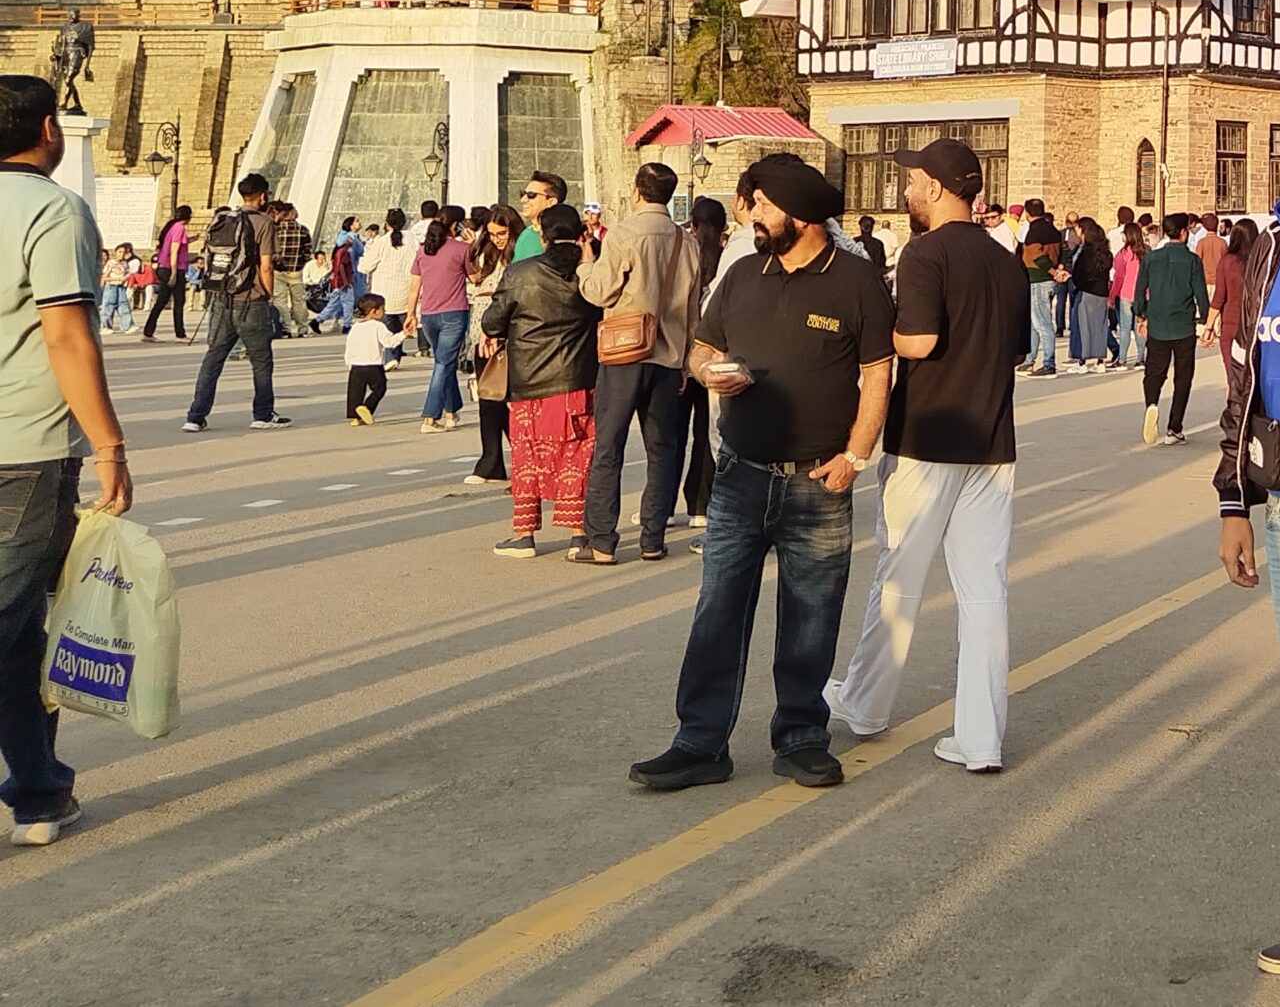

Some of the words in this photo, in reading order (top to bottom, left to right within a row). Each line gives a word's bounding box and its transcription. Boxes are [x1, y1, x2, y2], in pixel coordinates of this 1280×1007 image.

[876, 55, 898, 66] STATE
[898, 52, 927, 64] LIBRARY
[806, 319, 839, 333] COUTURE
[75, 626, 109, 647] Complete
[111, 637, 135, 651] Man
[56, 647, 126, 688] Raymond
[95, 700, 127, 714] 1925
